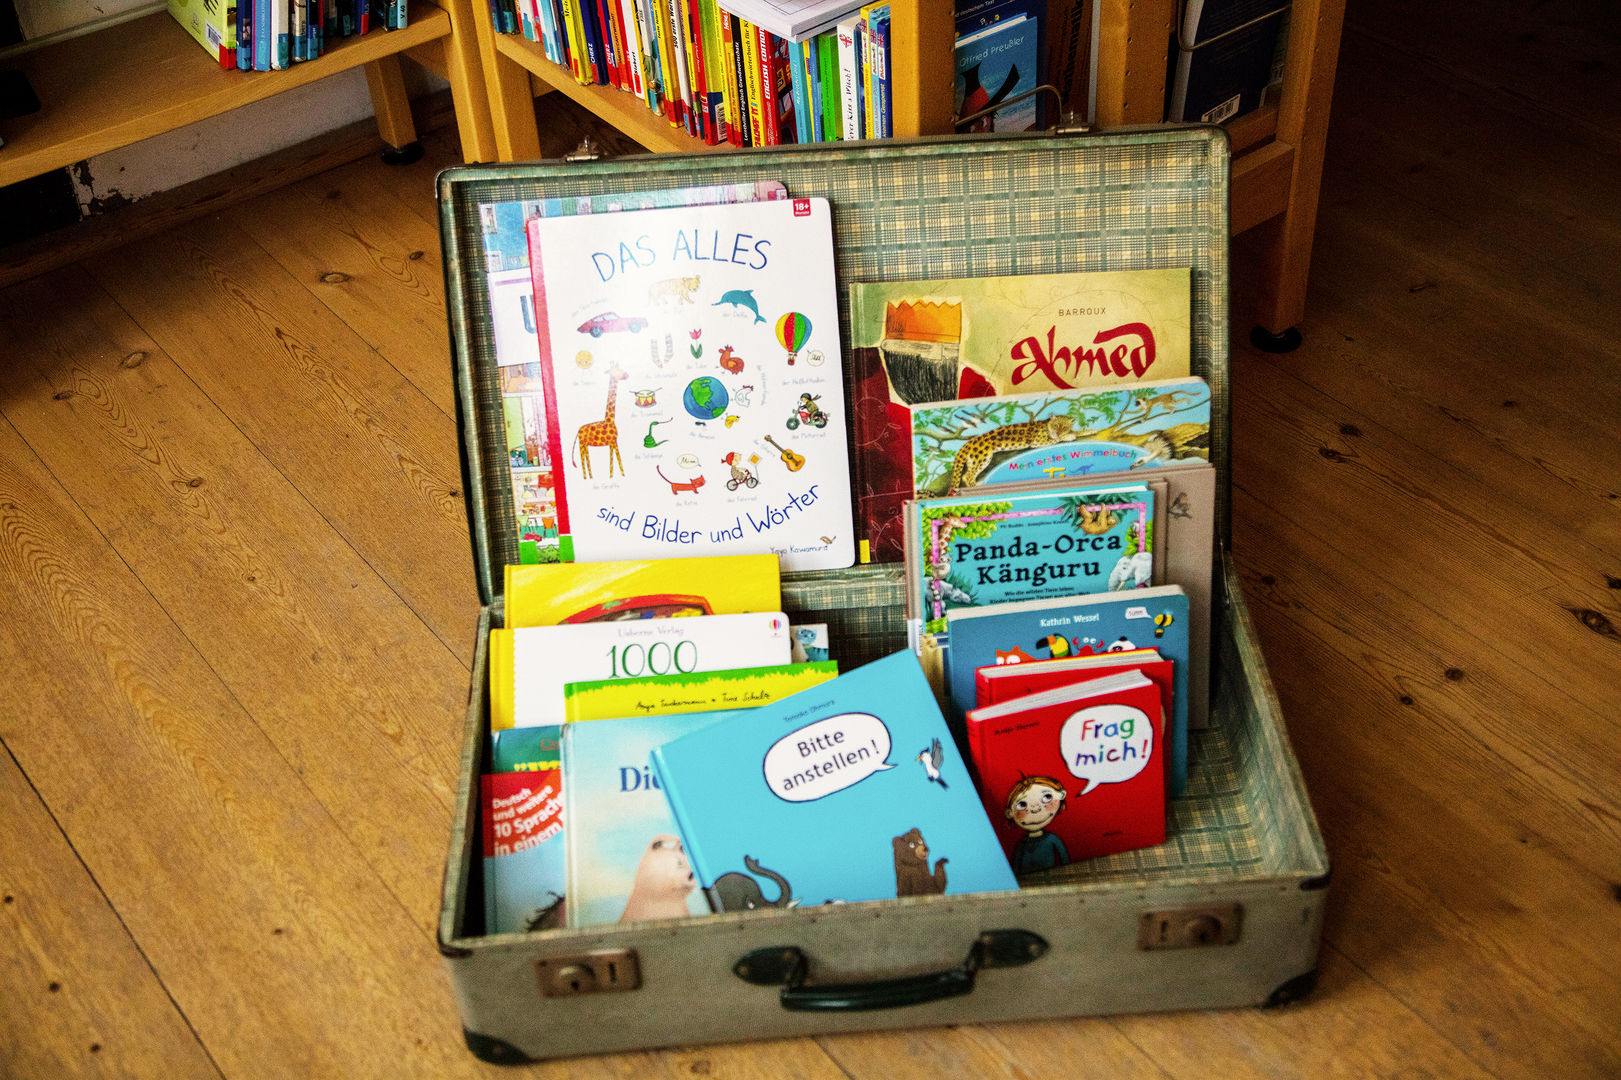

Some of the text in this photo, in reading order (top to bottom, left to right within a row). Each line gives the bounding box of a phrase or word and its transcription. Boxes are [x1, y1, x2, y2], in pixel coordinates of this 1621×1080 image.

[761, 64, 771, 99] ENGLISH
[794, 203, 809, 211] 18+
[592, 229, 771, 282] DAS ALLES
[1058, 307, 1107, 317] BARROUX
[1008, 448, 1137, 471] Mein erstes Wimmelbuch
[597, 484, 819, 544] sind Bilder und Wörter
[955, 535, 1122, 563] Panda-Orca
[977, 561, 1101, 587] Känguru
[1040, 613, 1099, 628] Kathrin Wessel
[607, 640, 698, 679] 1000
[797, 730, 845, 758] Bitte
[1080, 718, 1135, 742] Frag
[1075, 739, 1148, 767] mich!
[492, 787, 532, 809] Deutsch
[493, 784, 554, 822] und weitere
[494, 791, 563, 838] 10 Sprach
[494, 820, 563, 857] in einem
